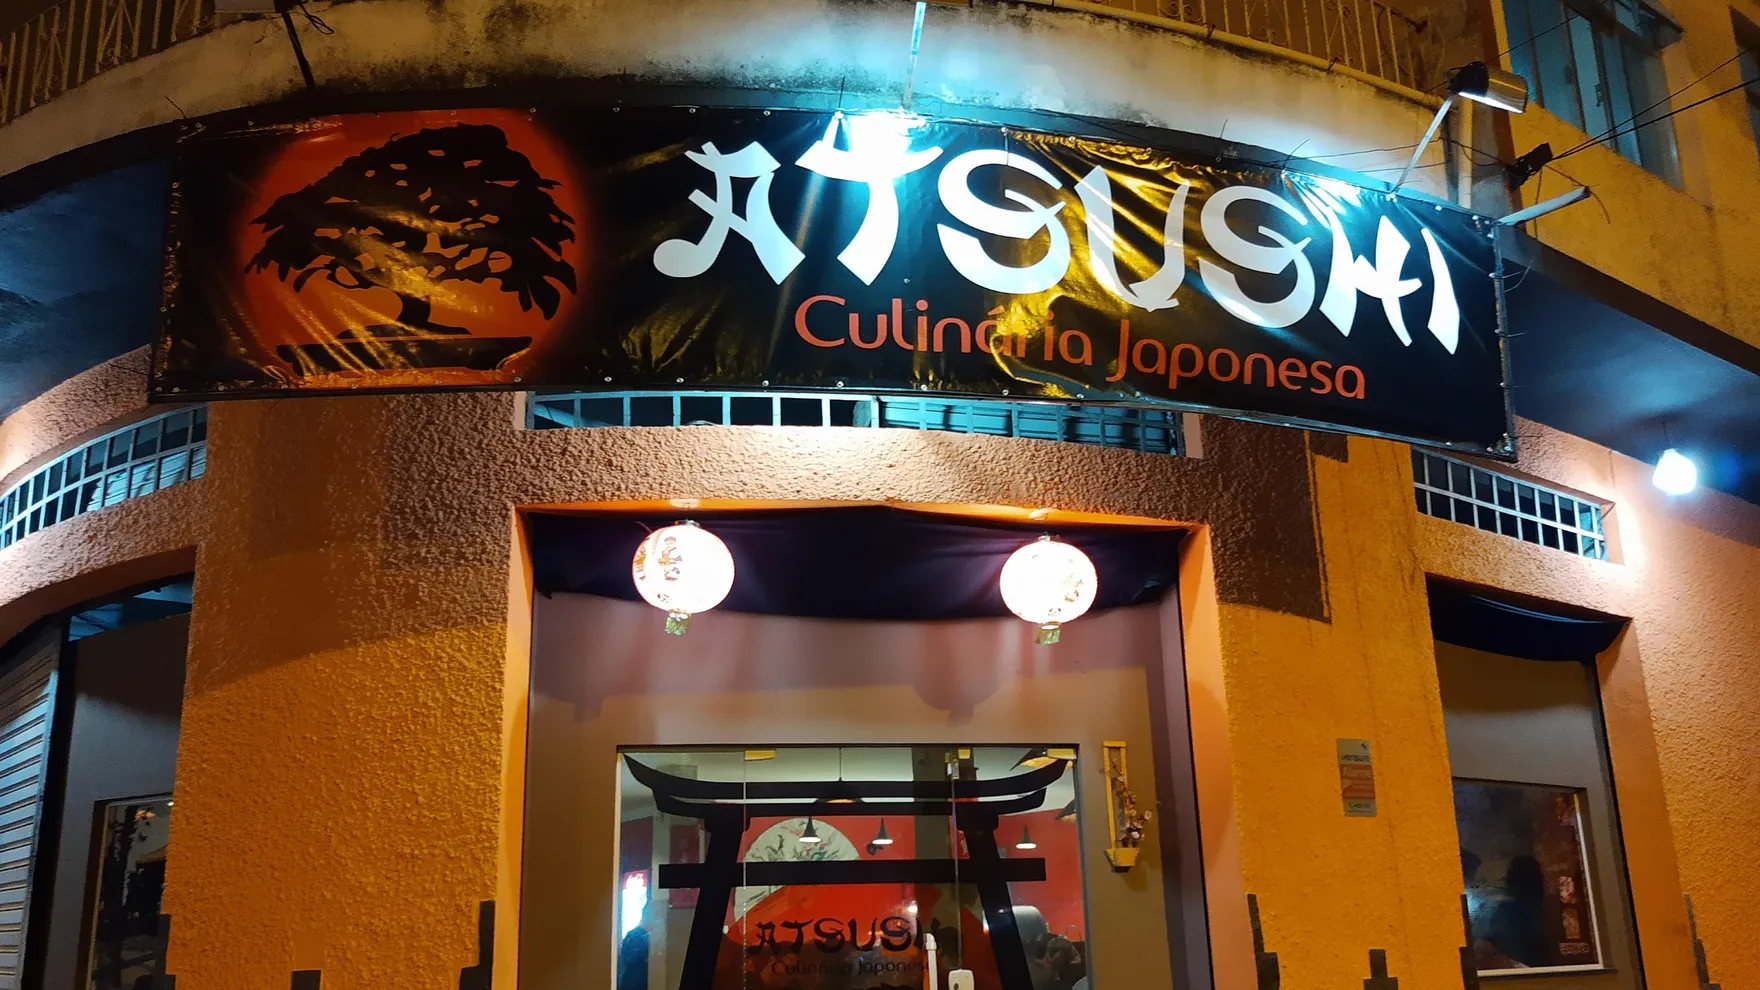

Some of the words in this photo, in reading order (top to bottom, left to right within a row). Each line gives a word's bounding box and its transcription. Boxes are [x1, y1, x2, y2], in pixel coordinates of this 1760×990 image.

[653, 140, 1460, 355] ATSUSHI
[794, 294, 1092, 366] Culinária
[1105, 319, 1366, 400] Japonesa
